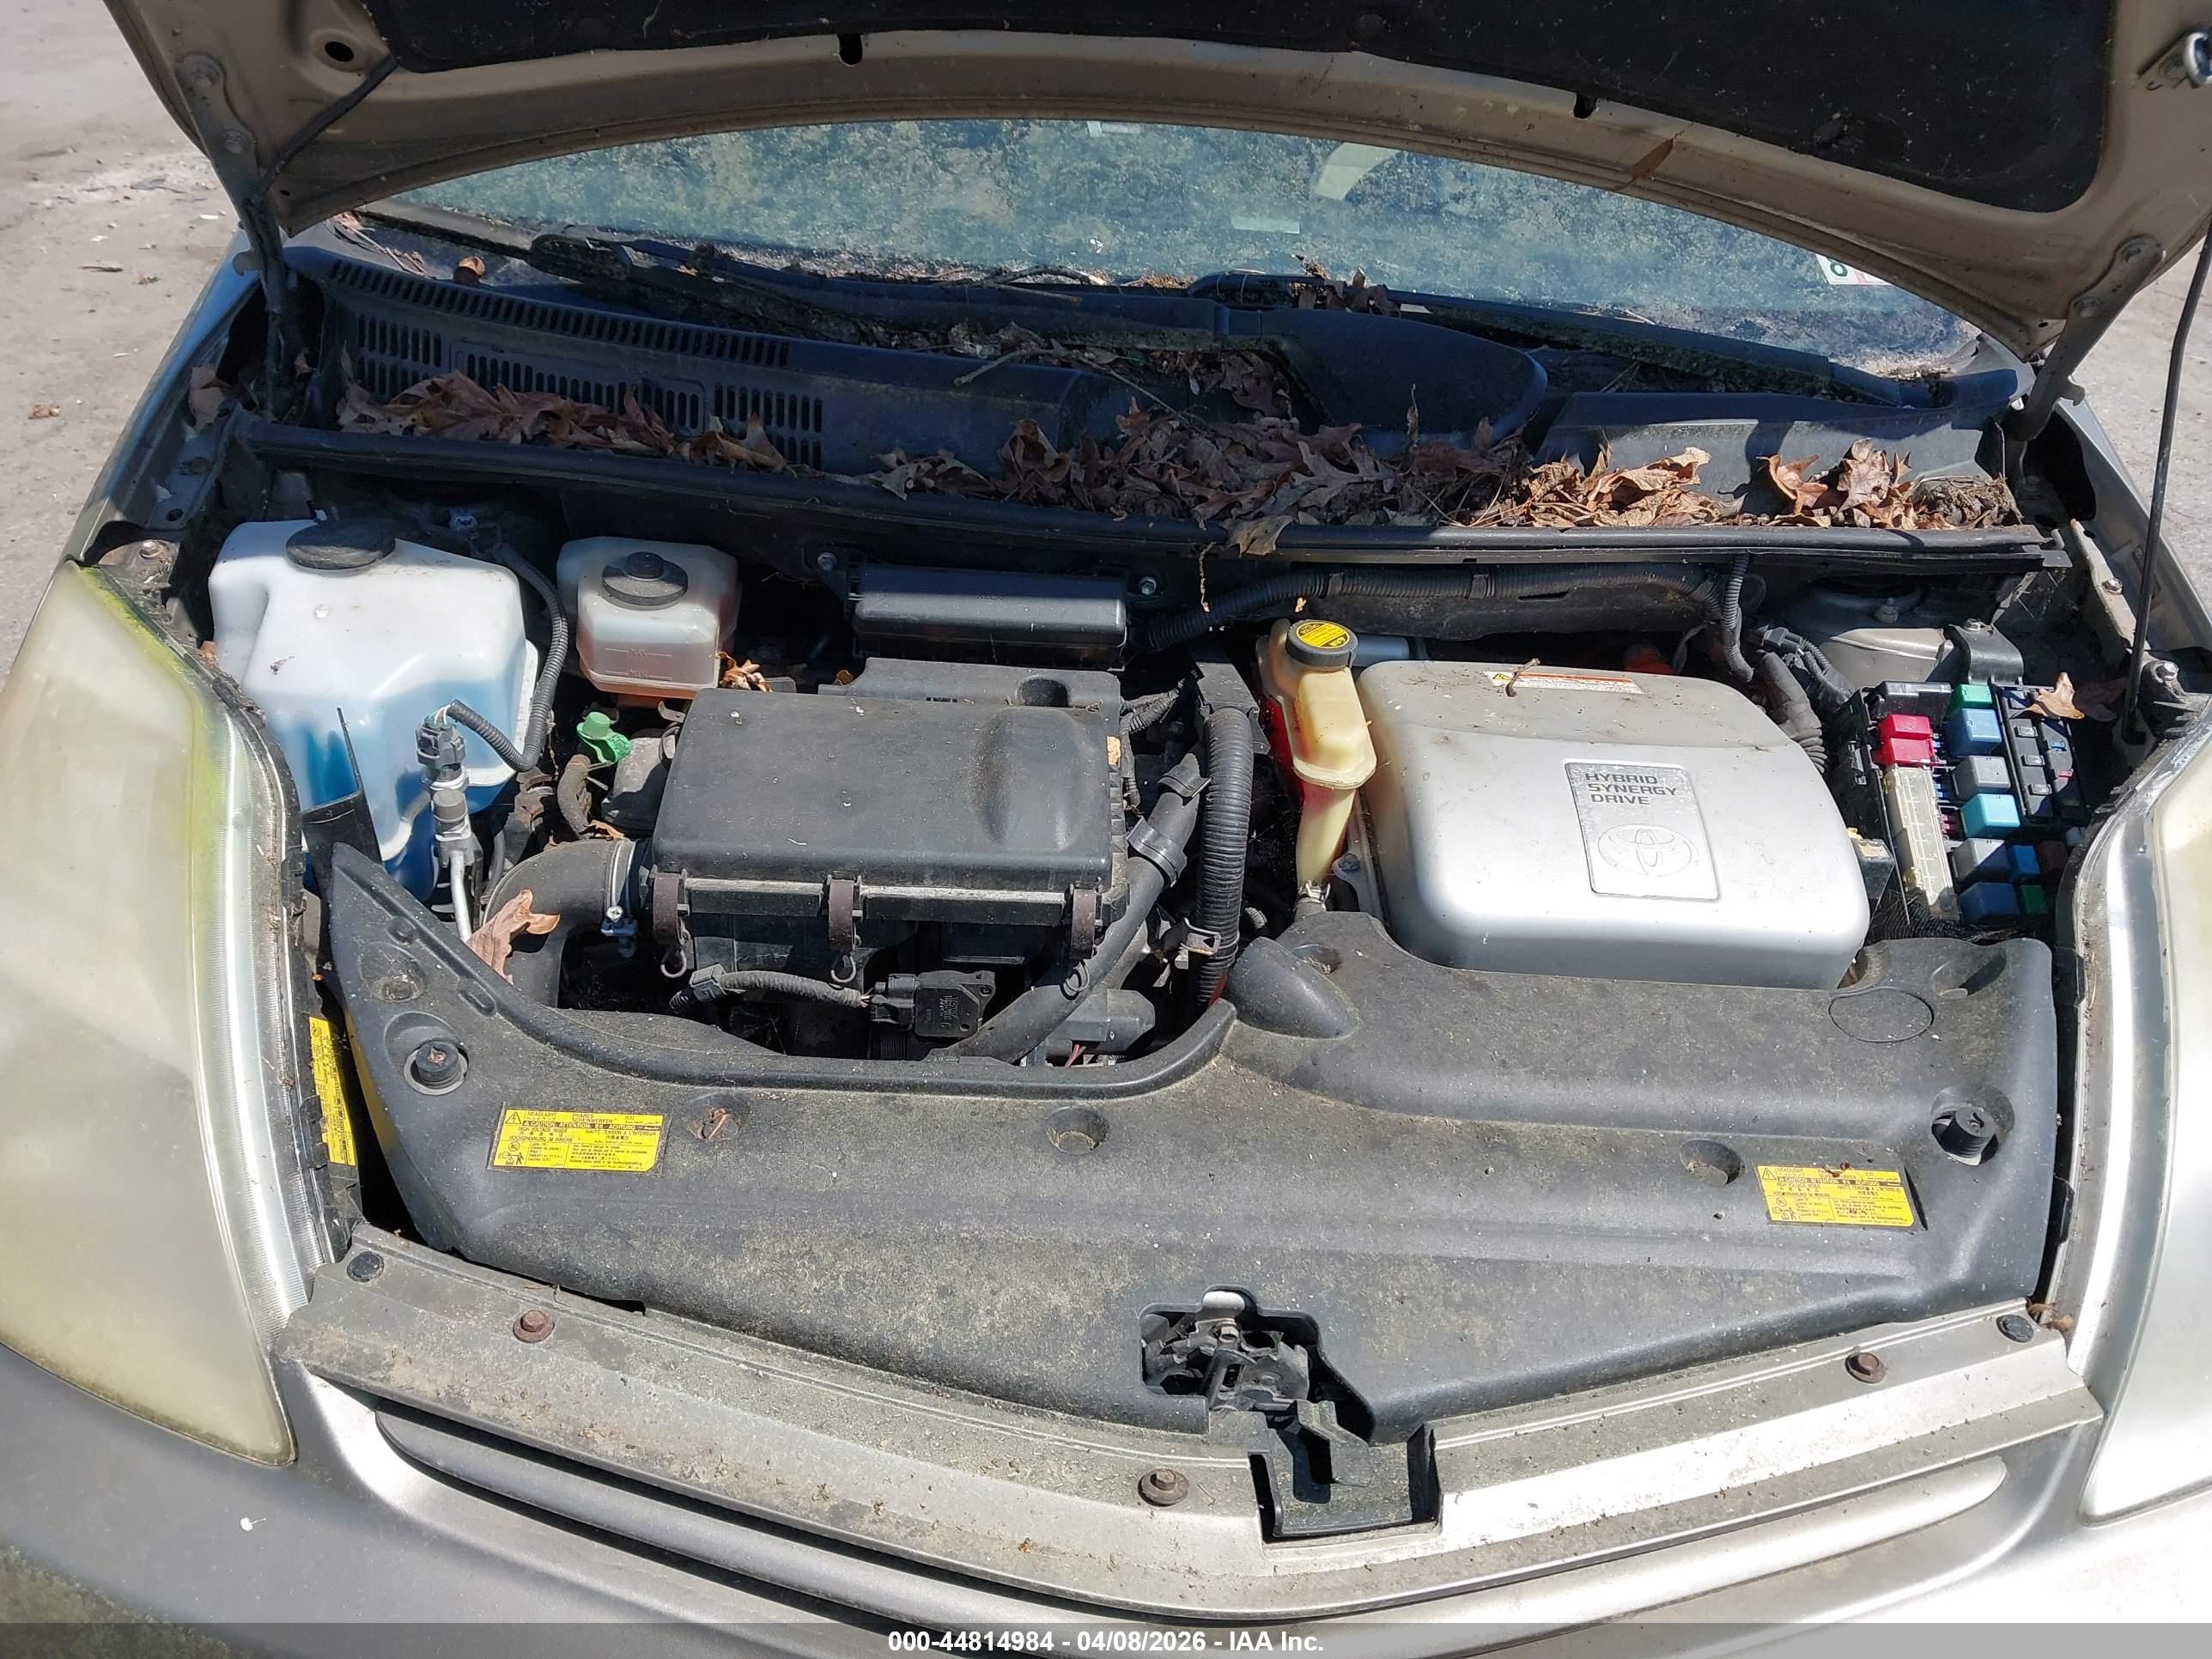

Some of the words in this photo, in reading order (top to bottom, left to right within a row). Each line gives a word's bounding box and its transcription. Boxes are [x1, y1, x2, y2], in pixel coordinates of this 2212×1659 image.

[1585, 773, 1658, 785] HYBRID
[1588, 783, 1677, 796] SYNERGY
[1591, 793, 1650, 805] DRIVE
